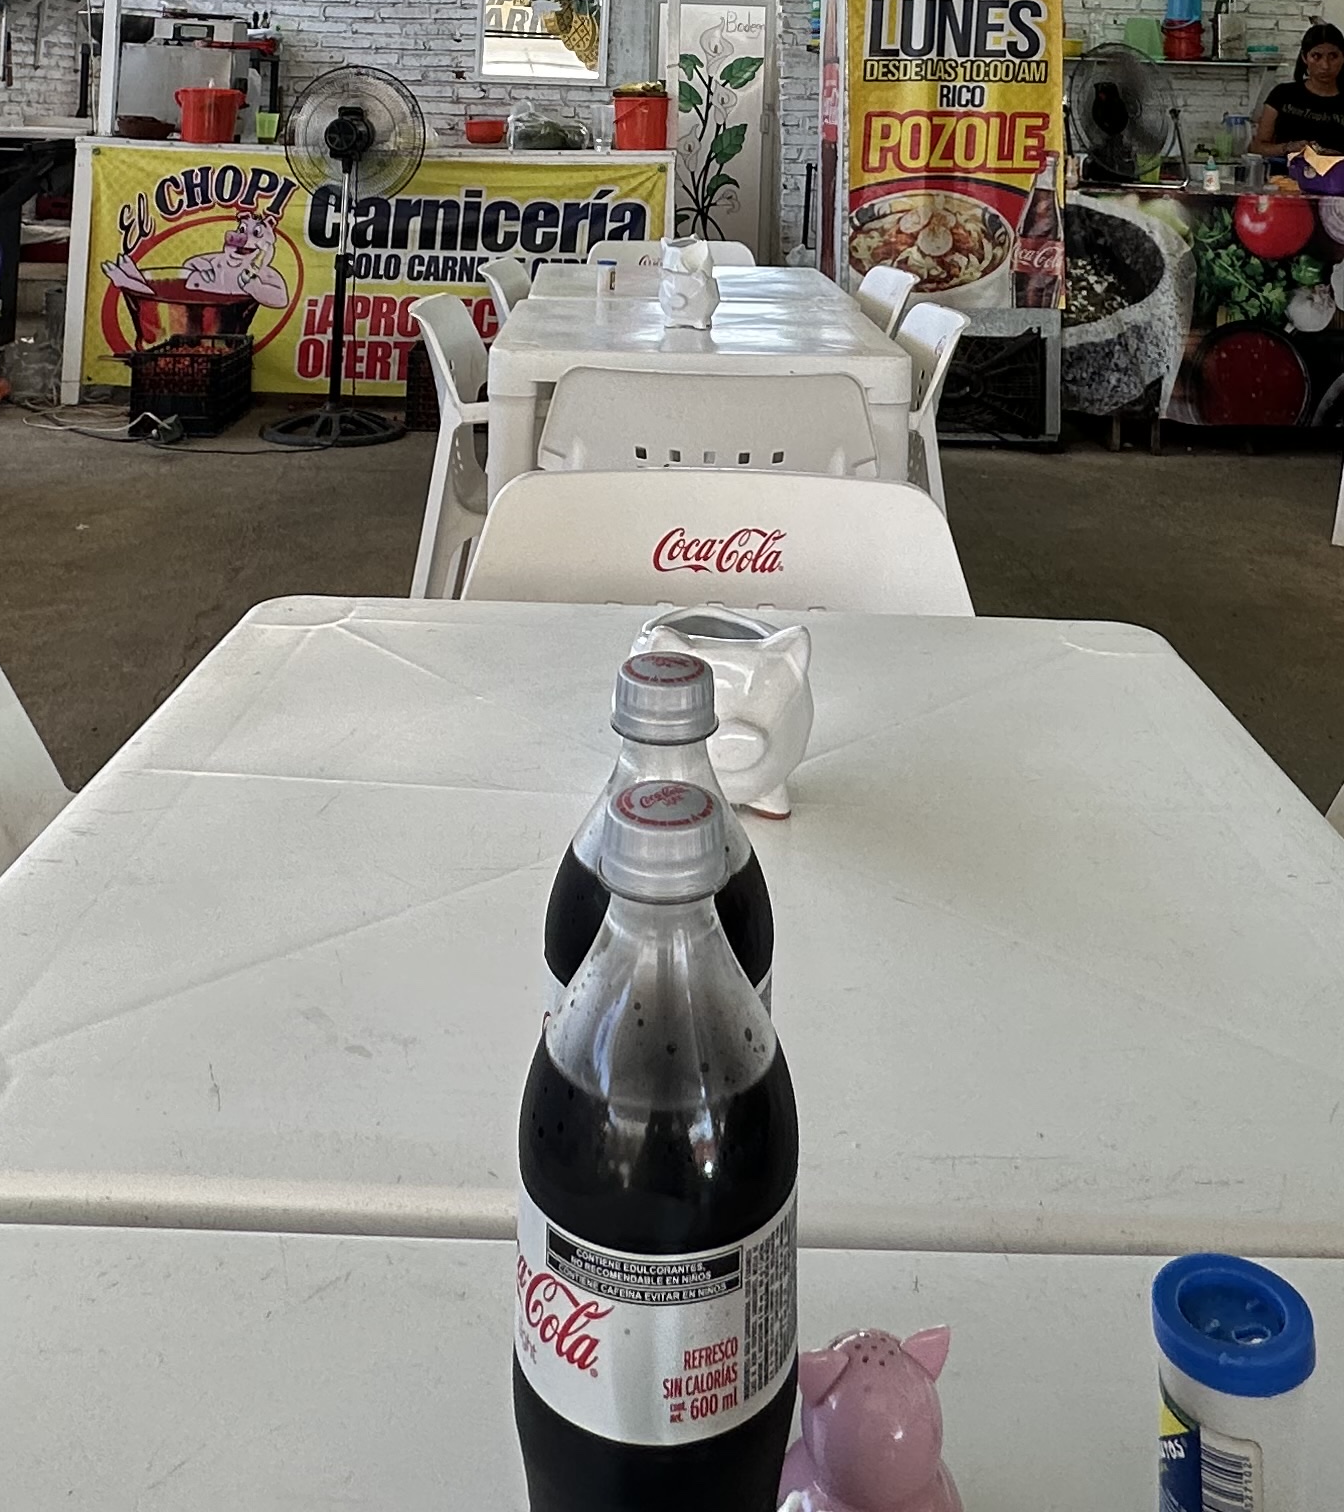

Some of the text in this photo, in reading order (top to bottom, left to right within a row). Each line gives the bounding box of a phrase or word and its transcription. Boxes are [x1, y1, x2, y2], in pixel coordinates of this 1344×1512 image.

[864, 59, 1048, 82] DESDE LAS 10:00 AM
[939, 84, 985, 108] RICO
[866, 114, 1045, 170] POZOLE
[119, 164, 298, 253] El CHOPI
[307, 184, 648, 254] Carnicería
[652, 526, 788, 575] Coca-Cola
[584, 1261, 663, 1286] RECOMENDABLE
[665, 1275, 680, 1285] EN
[644, 1289, 680, 1302] EVITAR
[683, 1335, 739, 1372] REFRESCO
[662, 1361, 738, 1400] SIN CALORÍAS
[689, 1392, 719, 1421] 600
[722, 1385, 738, 1412] ml
